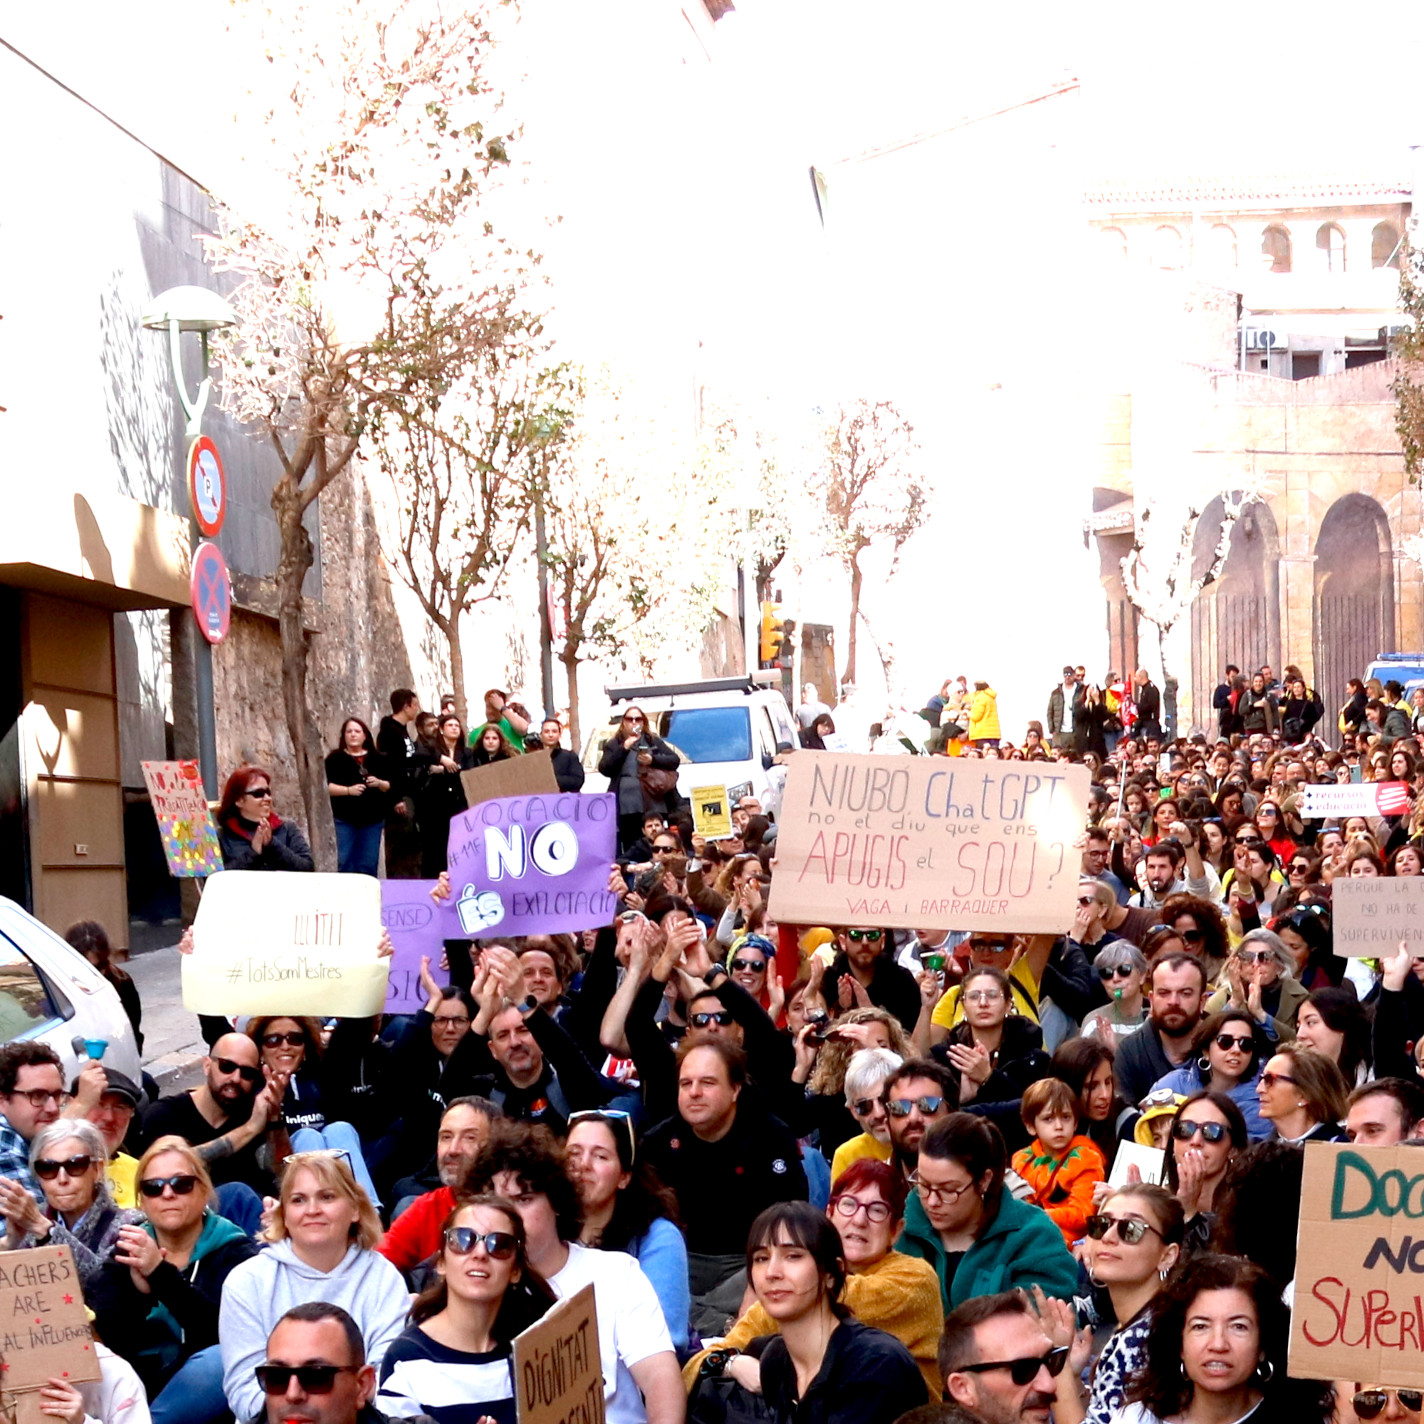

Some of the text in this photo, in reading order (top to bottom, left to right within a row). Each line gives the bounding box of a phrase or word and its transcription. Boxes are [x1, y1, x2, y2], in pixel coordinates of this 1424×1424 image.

[1315, 791, 1364, 799] recursos
[808, 812, 834, 825] no
[892, 811, 926, 831] diu
[945, 822, 981, 837] que
[1003, 823, 1038, 836] ens
[483, 820, 579, 881] NO
[798, 830, 909, 890] APUGIS
[916, 847, 934, 870] el
[953, 841, 1036, 898] SOU
[1394, 881, 1409, 893] LA
[456, 883, 506, 935] ÉS
[845, 898, 892, 915] VAGA
[920, 899, 1009, 915] BARRAQUER
[1361, 903, 1377, 915] NO
[1386, 903, 1401, 915] HA
[1406, 903, 1418, 915] DE
[13, 1290, 51, 1317] ARE
